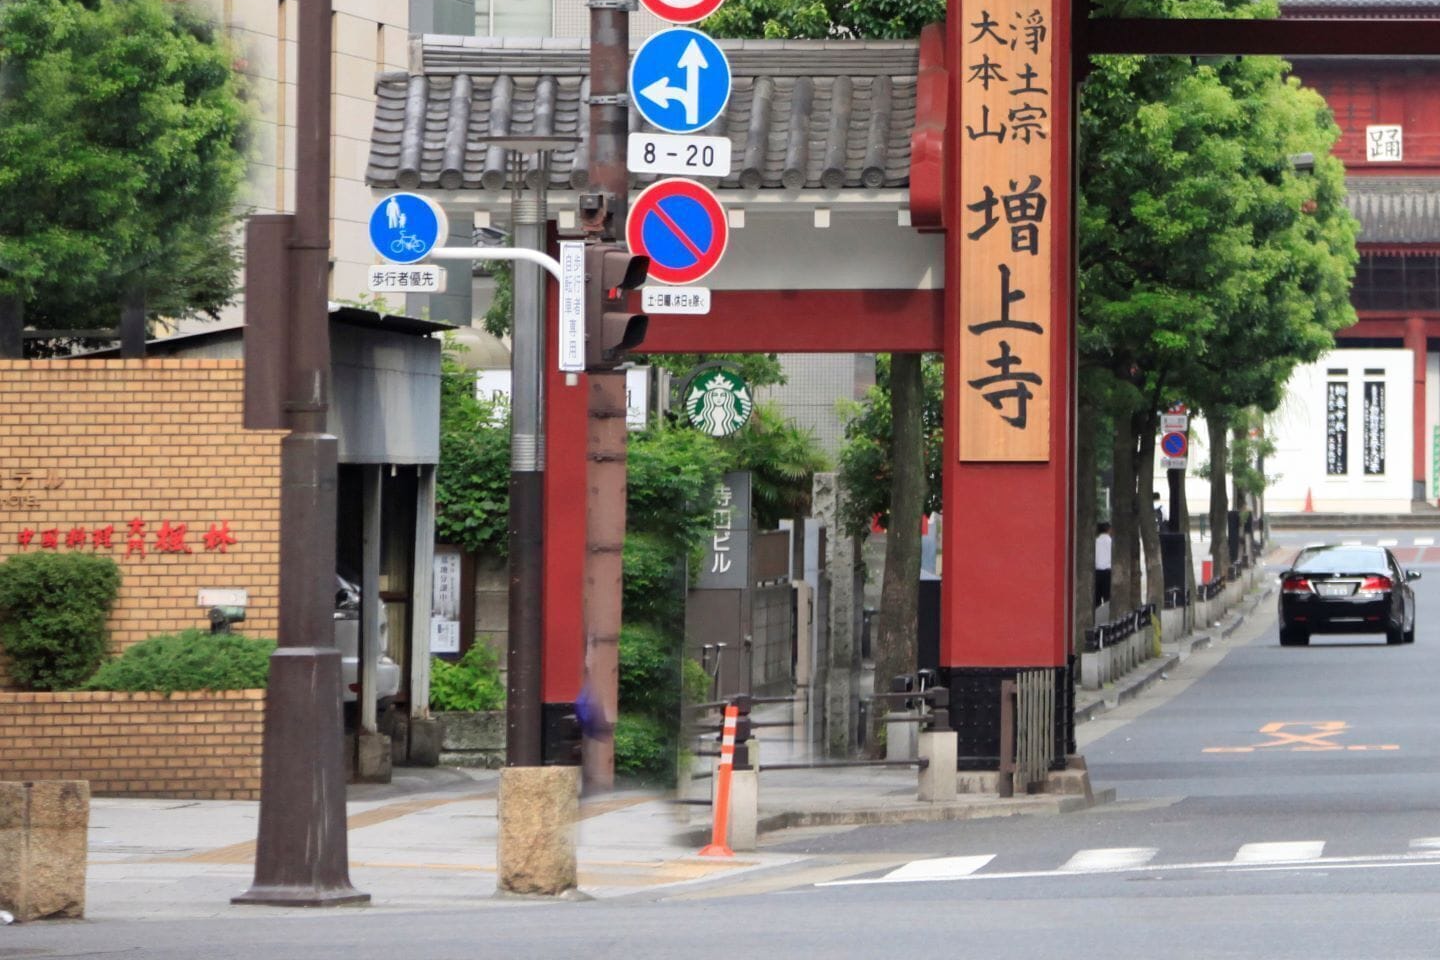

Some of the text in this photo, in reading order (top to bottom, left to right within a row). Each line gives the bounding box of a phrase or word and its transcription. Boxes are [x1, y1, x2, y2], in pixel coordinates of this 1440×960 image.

[966, 10, 1008, 145] 大本山
[373, 271, 434, 287] 歩行者優先
